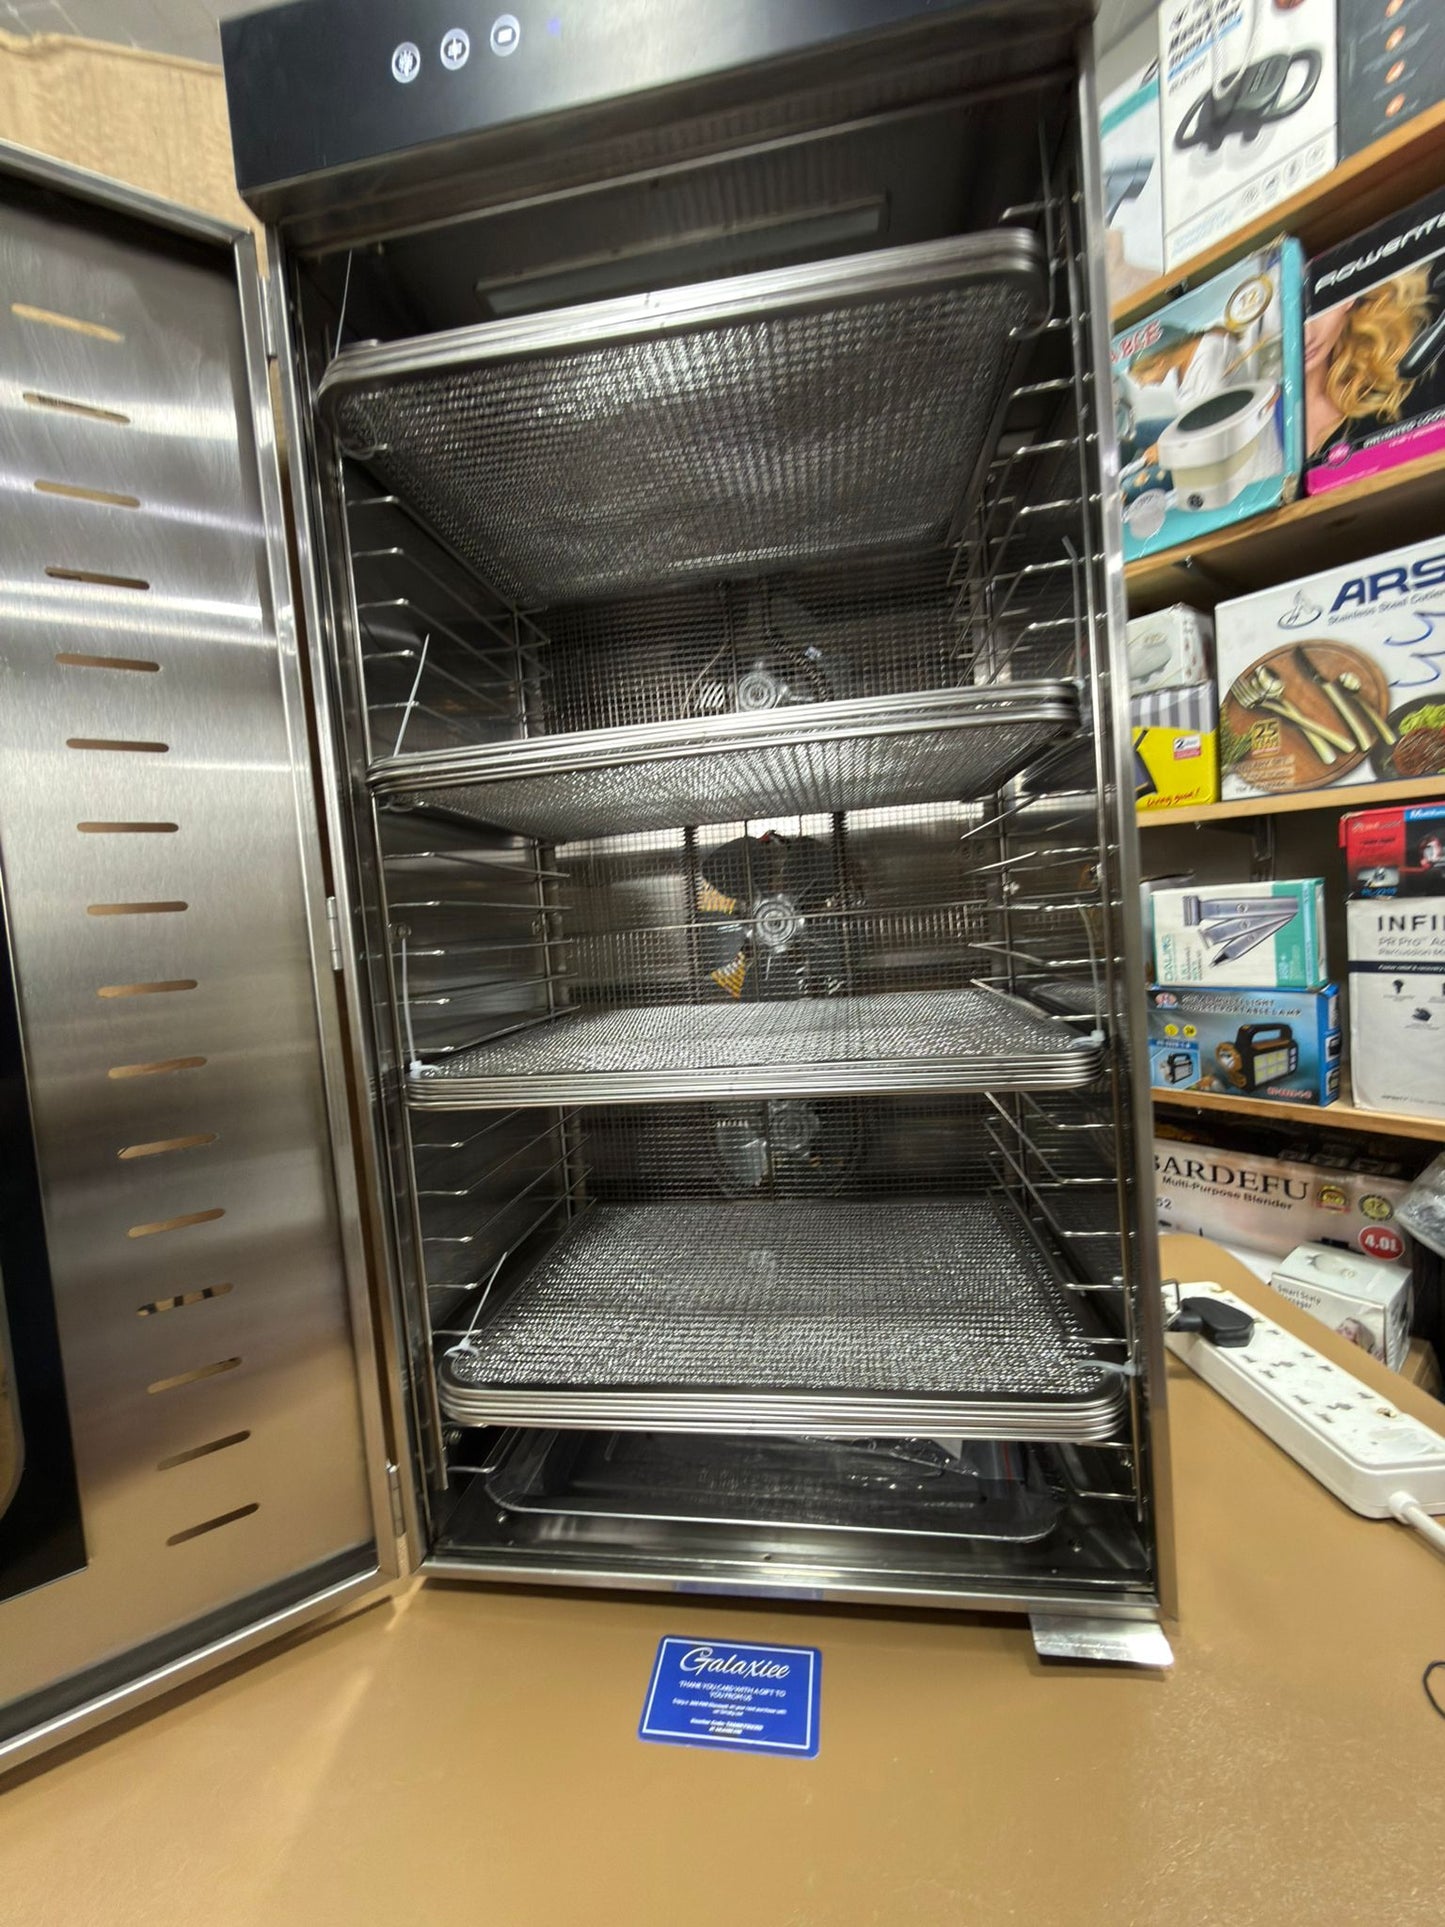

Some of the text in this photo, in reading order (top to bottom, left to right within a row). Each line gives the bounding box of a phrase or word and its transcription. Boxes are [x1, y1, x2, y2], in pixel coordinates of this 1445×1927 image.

[1254, 720, 1278, 740] 25
[1377, 914, 1445, 932] INFI
[1162, 1175, 1294, 1211] Multi-Purpose Blender
[1365, 1233, 1400, 1253] 4.0L
[679, 1647, 790, 1680] Galaxiee
